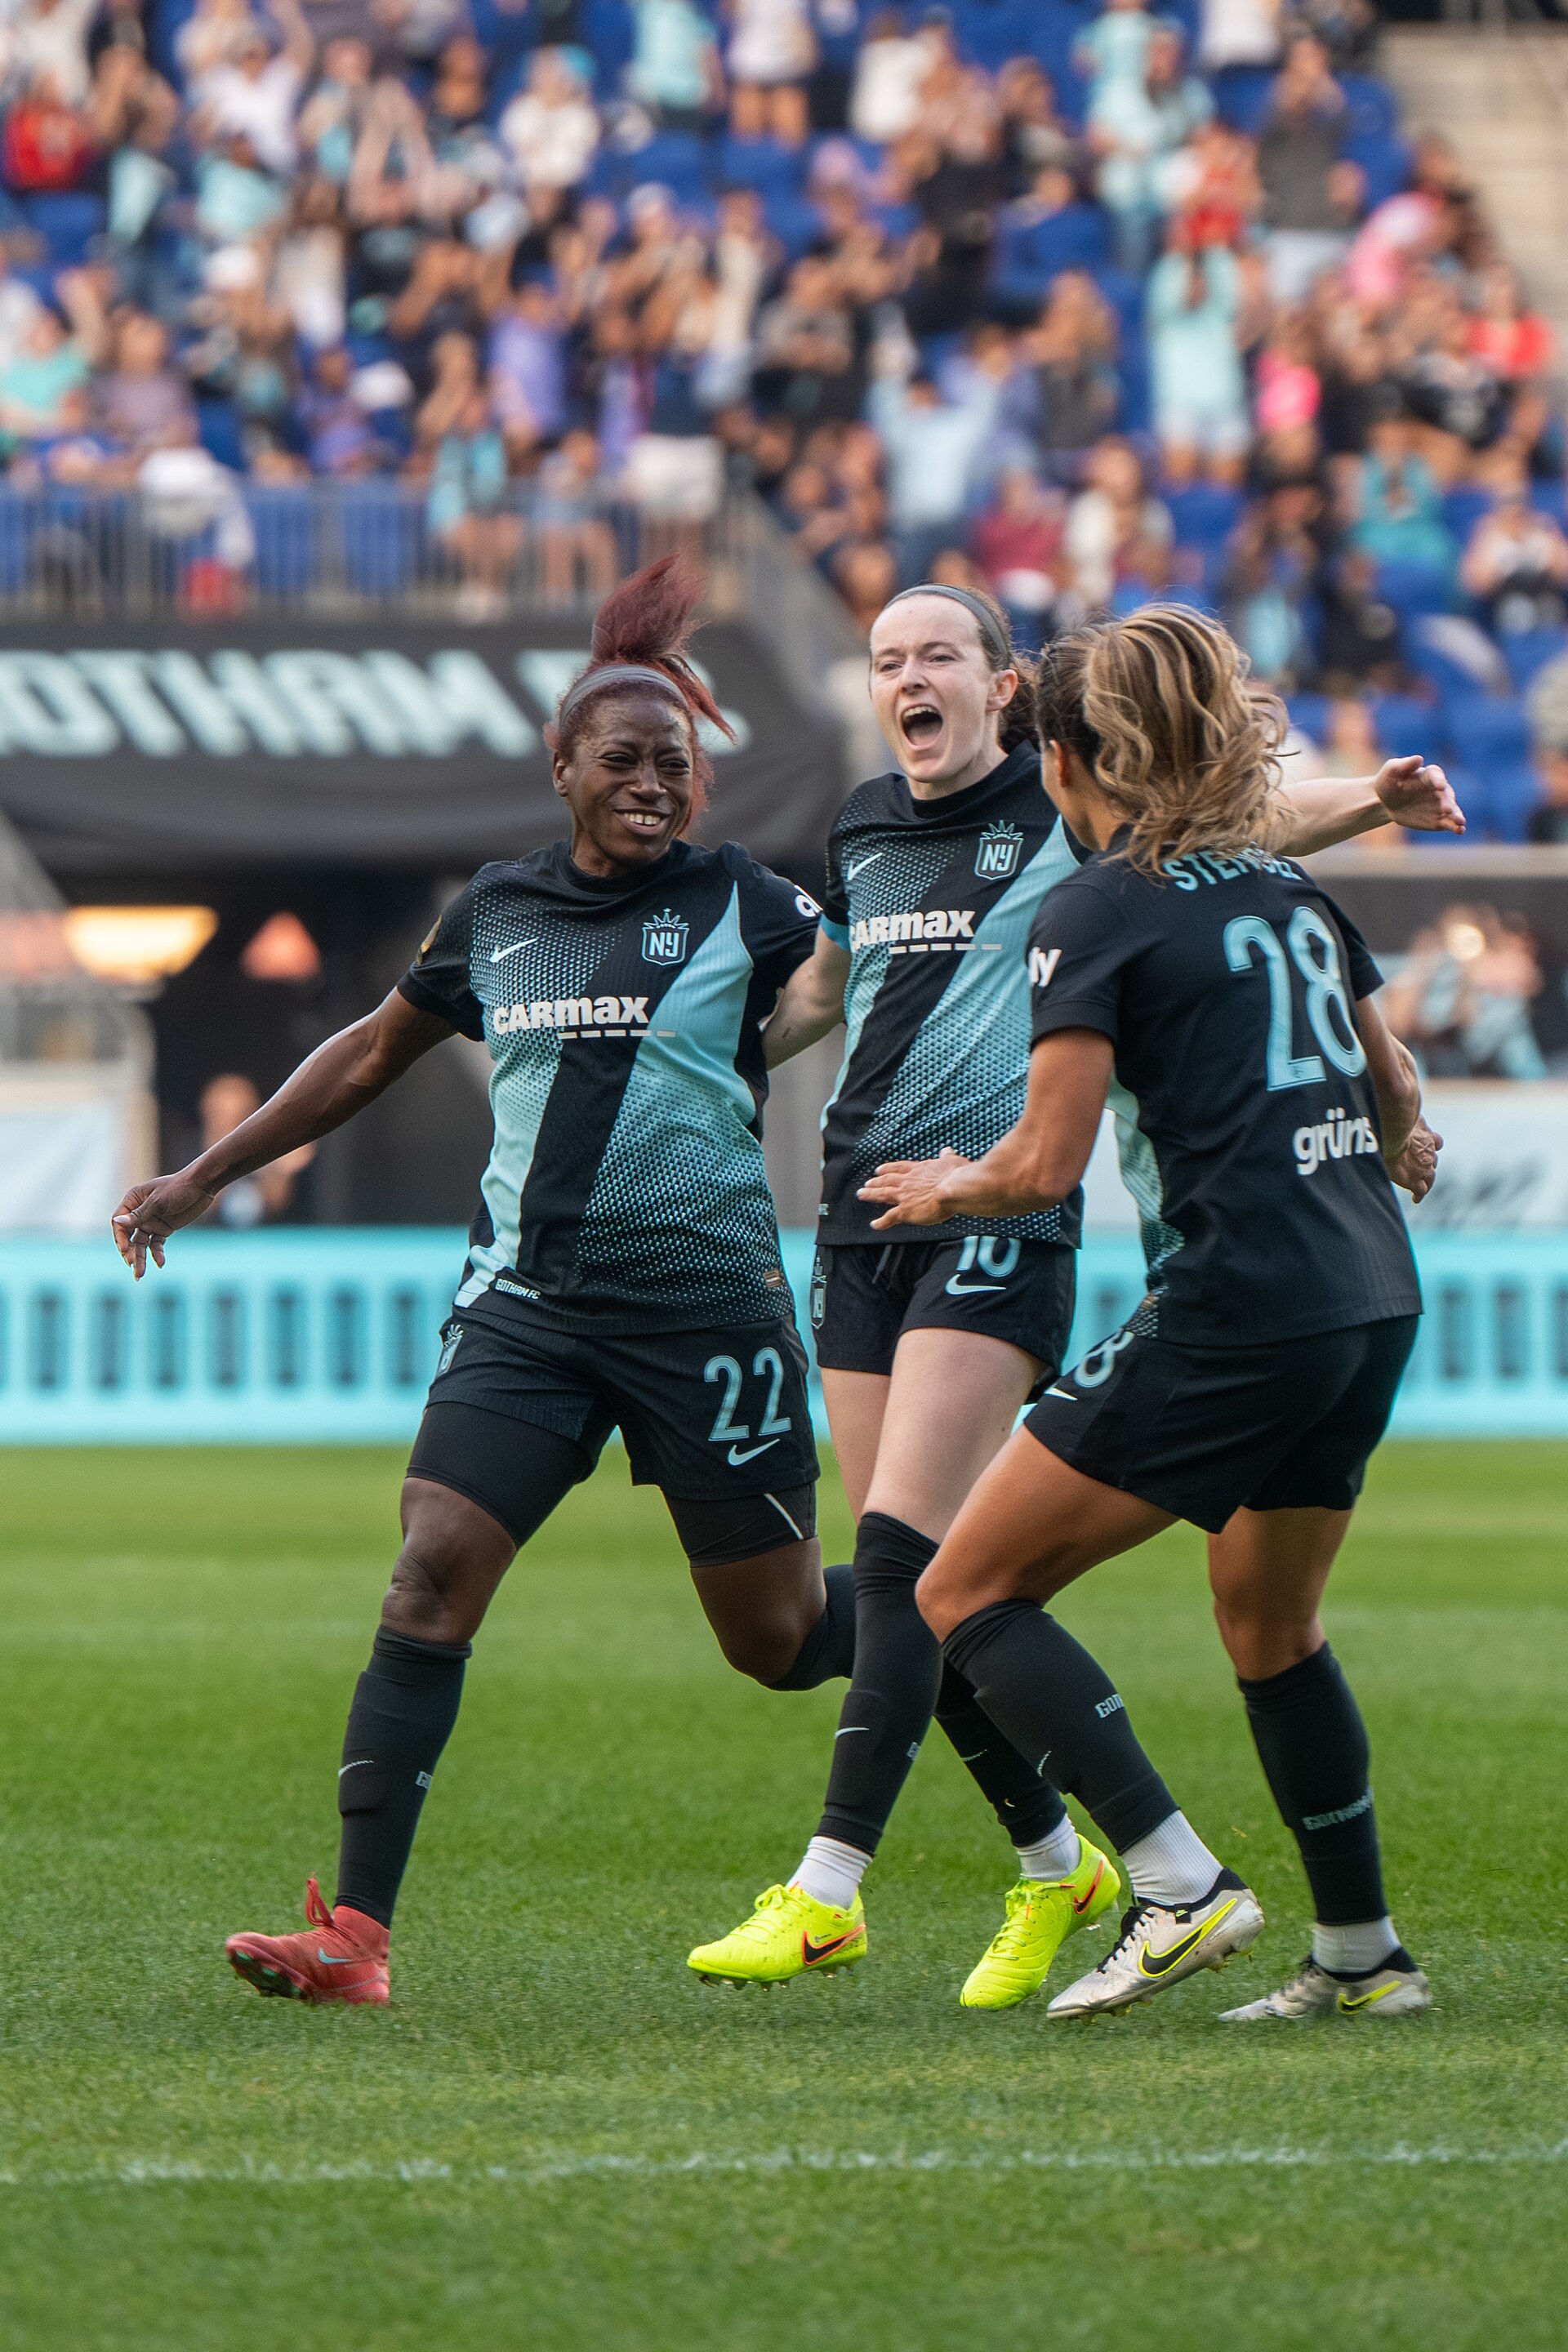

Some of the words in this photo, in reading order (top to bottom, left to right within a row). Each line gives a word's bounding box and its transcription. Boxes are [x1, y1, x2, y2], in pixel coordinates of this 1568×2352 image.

[0, 648, 536, 759] OTHAM
[493, 996, 649, 1035] CARmax
[1223, 906, 1368, 1092] 28
[1293, 1107, 1379, 1176] grüns
[703, 1347, 792, 1442] 22
